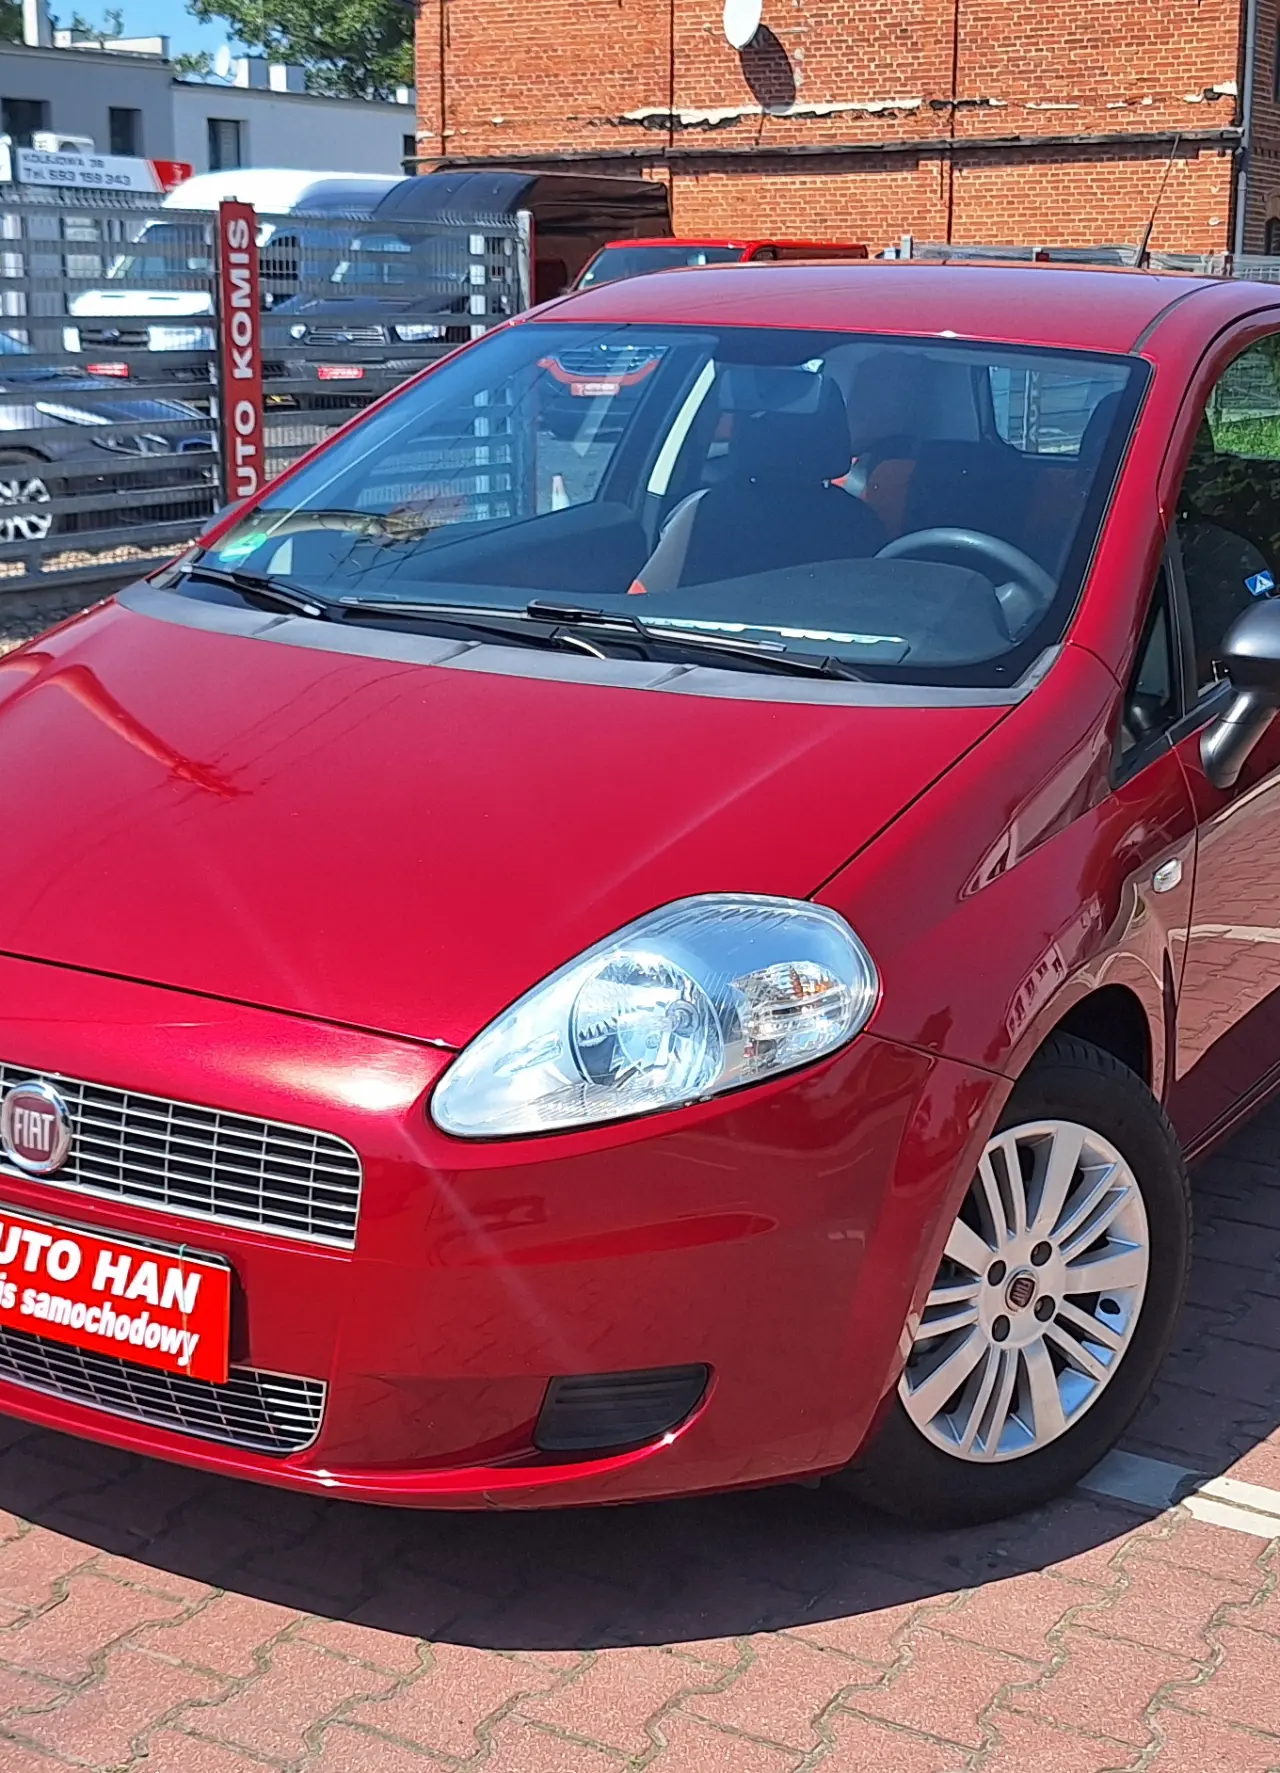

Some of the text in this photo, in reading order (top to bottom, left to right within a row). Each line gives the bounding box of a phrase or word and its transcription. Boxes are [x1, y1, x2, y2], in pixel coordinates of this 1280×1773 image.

[228, 218, 258, 497] UTO KOMIS
[13, 1106, 55, 1152] FIAT
[91, 1249, 203, 1315] HAN
[20, 1288, 200, 1367] samochodowy
